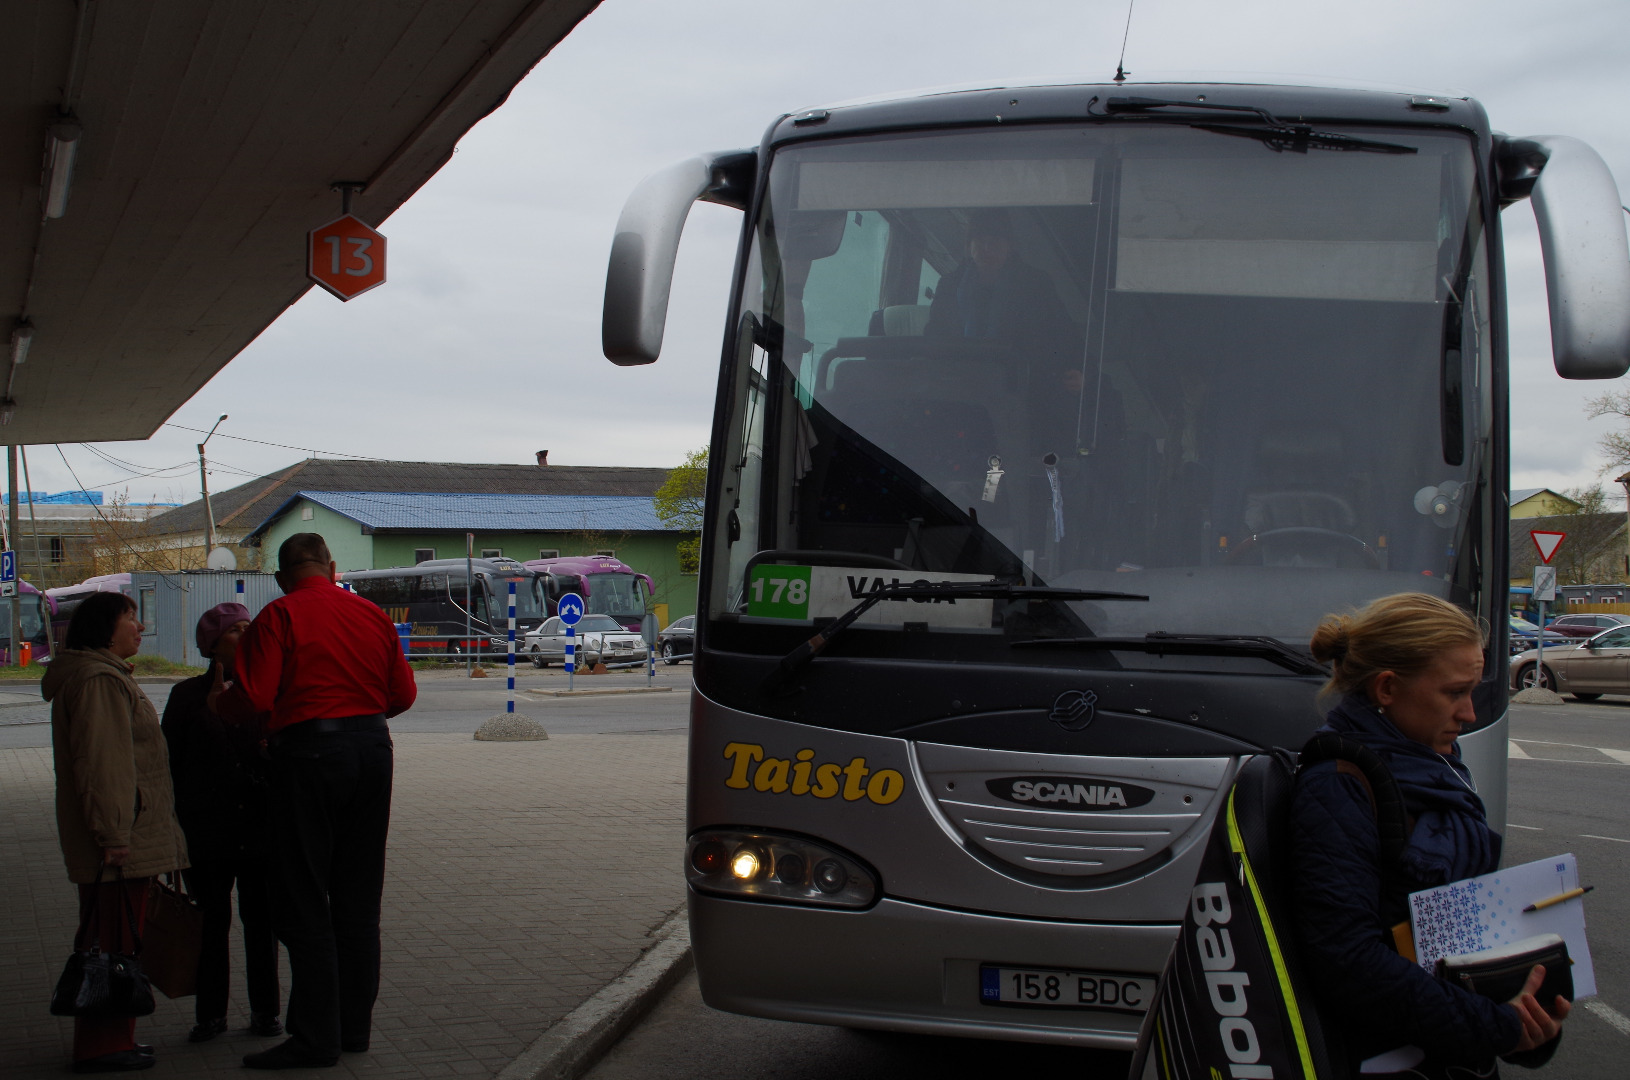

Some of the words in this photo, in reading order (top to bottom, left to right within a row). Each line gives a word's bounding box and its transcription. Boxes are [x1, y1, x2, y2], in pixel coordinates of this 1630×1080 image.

[323, 235, 374, 277] 13
[3, 555, 11, 578] P
[751, 577, 808, 605] 178
[723, 741, 905, 805] Taisto
[1011, 780, 1128, 807] SCANIA
[983, 988, 1000, 997] EST
[1012, 973, 1061, 1001] 158
[1078, 977, 1142, 1007] BDC
[1191, 881, 1275, 1080] Babol
